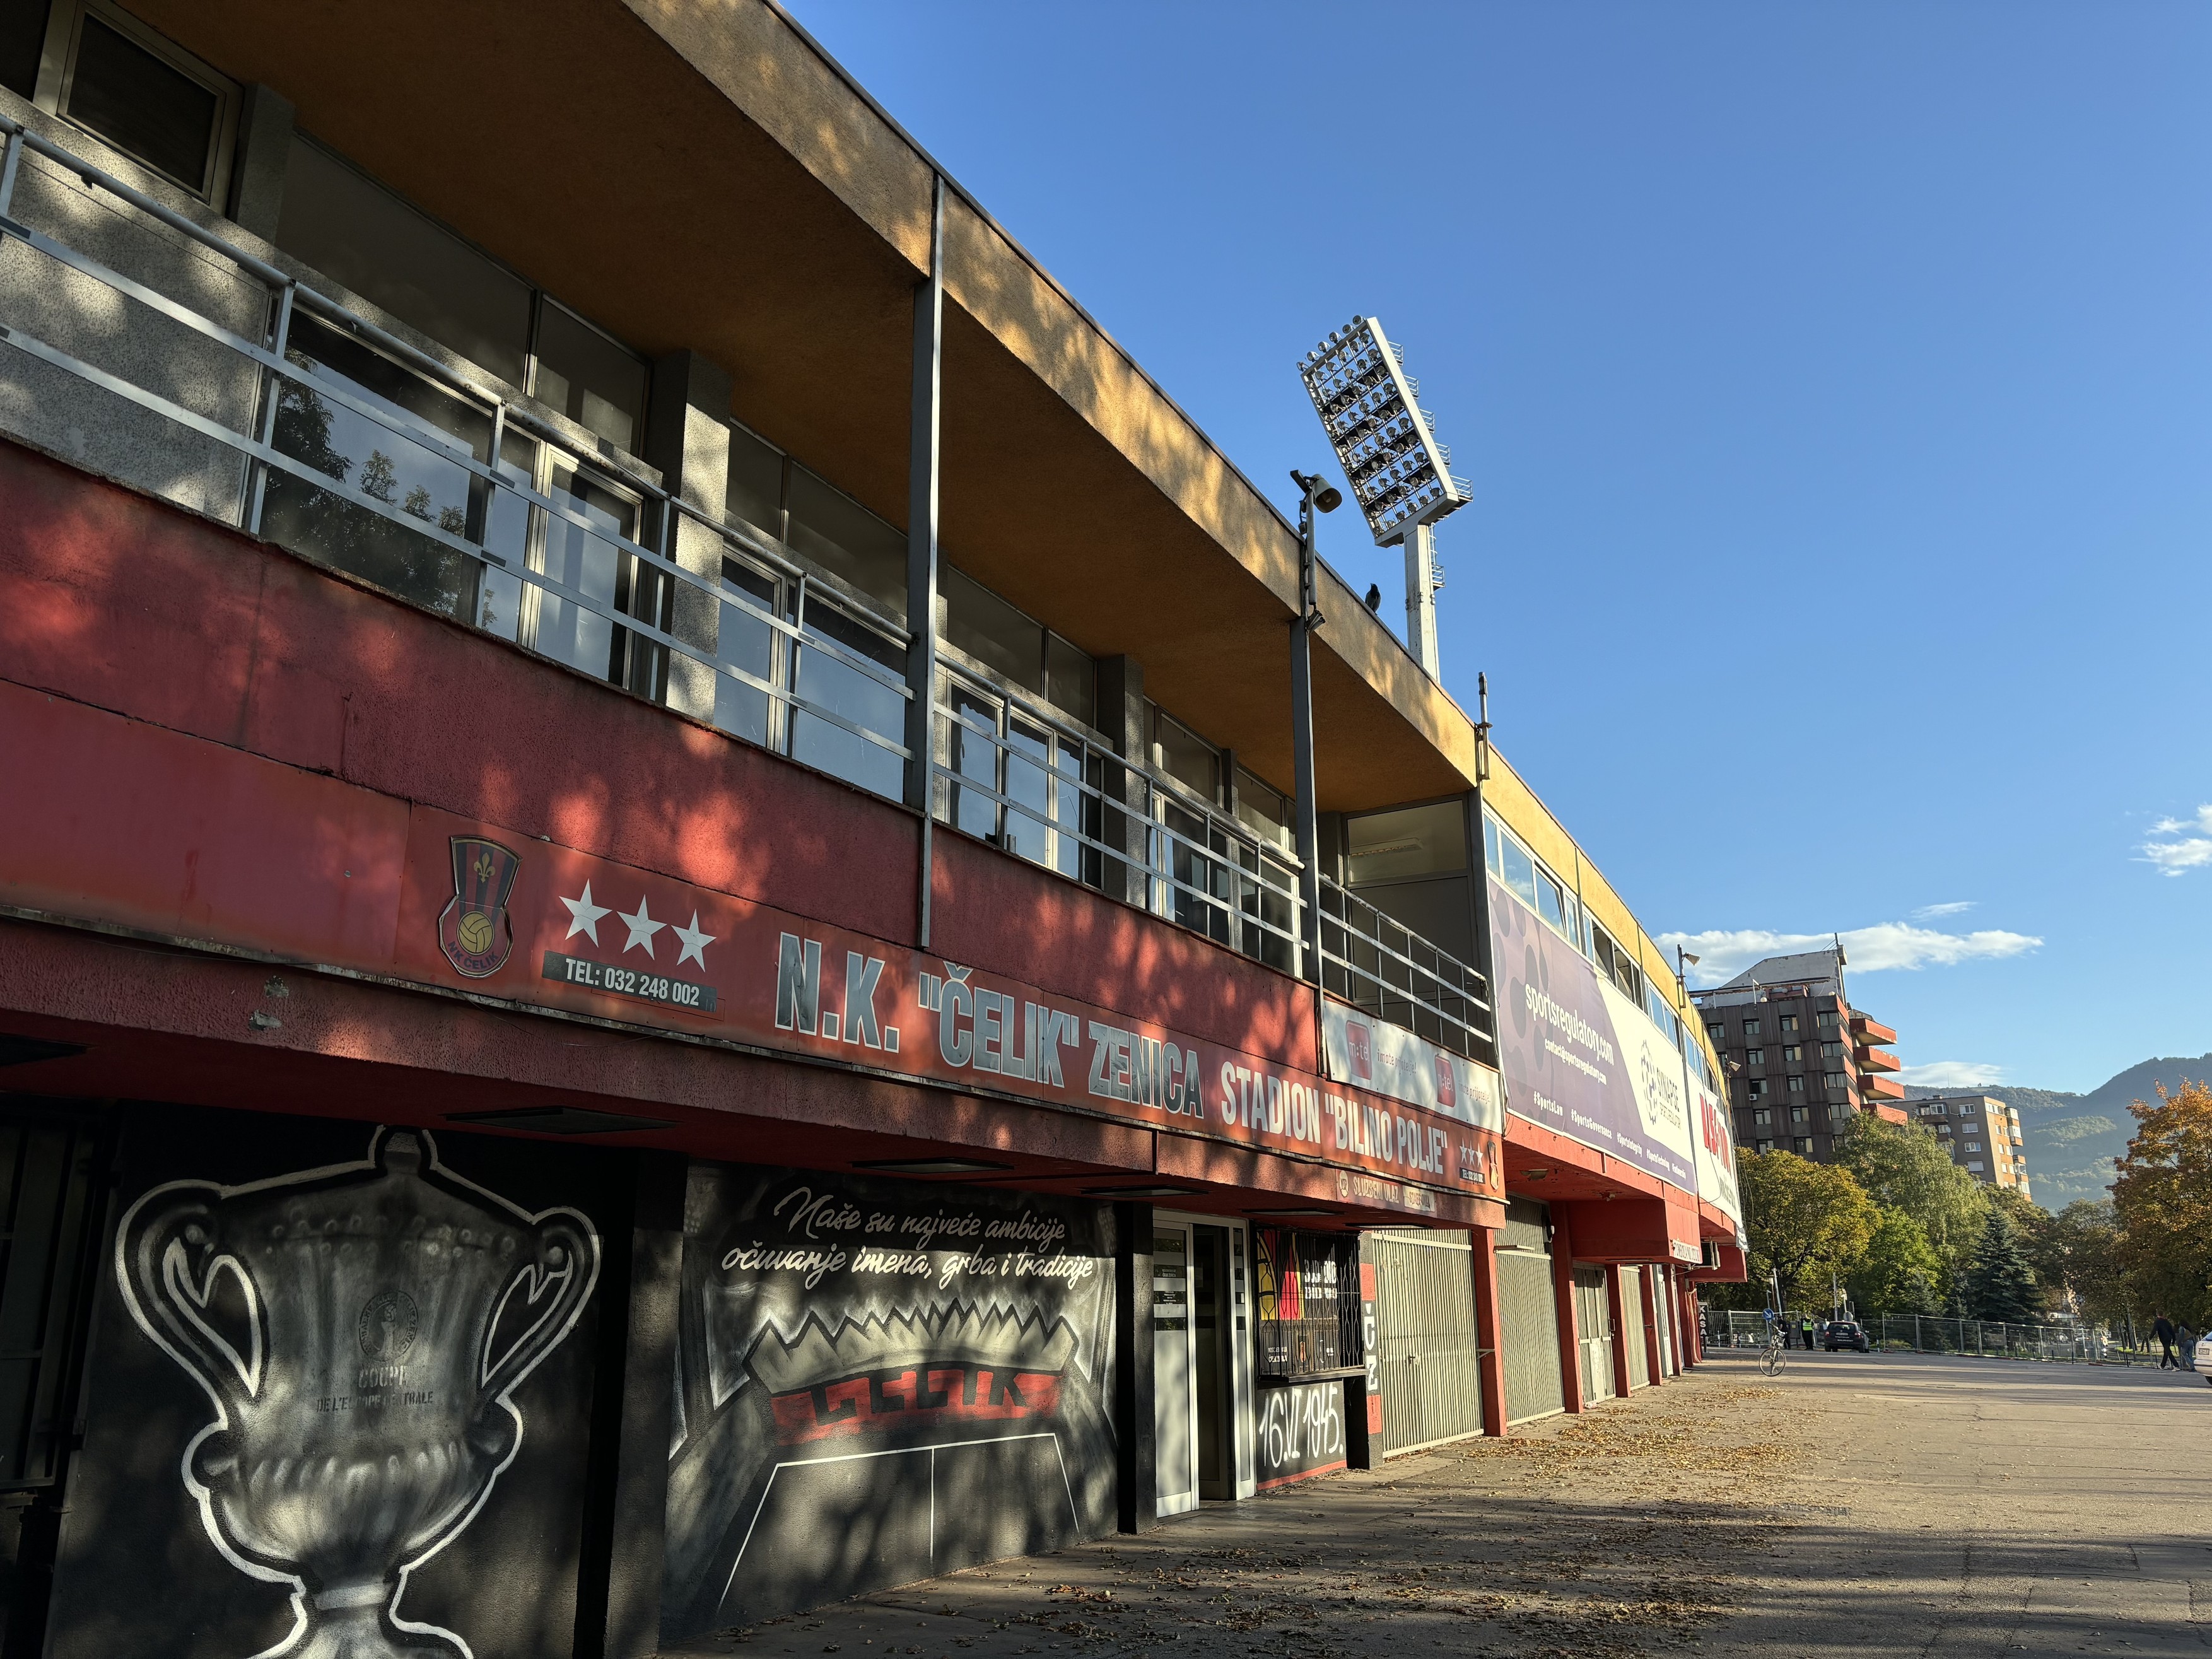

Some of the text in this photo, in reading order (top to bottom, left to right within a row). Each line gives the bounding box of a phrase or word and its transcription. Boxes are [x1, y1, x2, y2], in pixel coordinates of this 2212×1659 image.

[447, 941, 500, 970] NK ČELIK
[566, 958, 700, 1006] TEL: 032 248 002
[775, 931, 1204, 1120] N.K. "ČELIK" ZENICA
[1525, 983, 1615, 1066] sportsregulatory.com
[1349, 1041, 1370, 1062] m:tel
[1377, 1048, 1395, 1065] imate
[1220, 1060, 1448, 1175] STADION "BILINO POLJE"
[1533, 1091, 1563, 1117] #SportsLaw
[1384, 1183, 1400, 1204] ULAZ
[774, 1187, 1065, 1253] Naše su najveće ambicije
[722, 1240, 1094, 1291] očuvanje imena, grba i tradicije
[1699, 1306, 1707, 1335] KASA
[358, 1364, 409, 1388] COUPE
[317, 1397, 331, 1413] DE
[1302, 1382, 1343, 1458] 1945.
